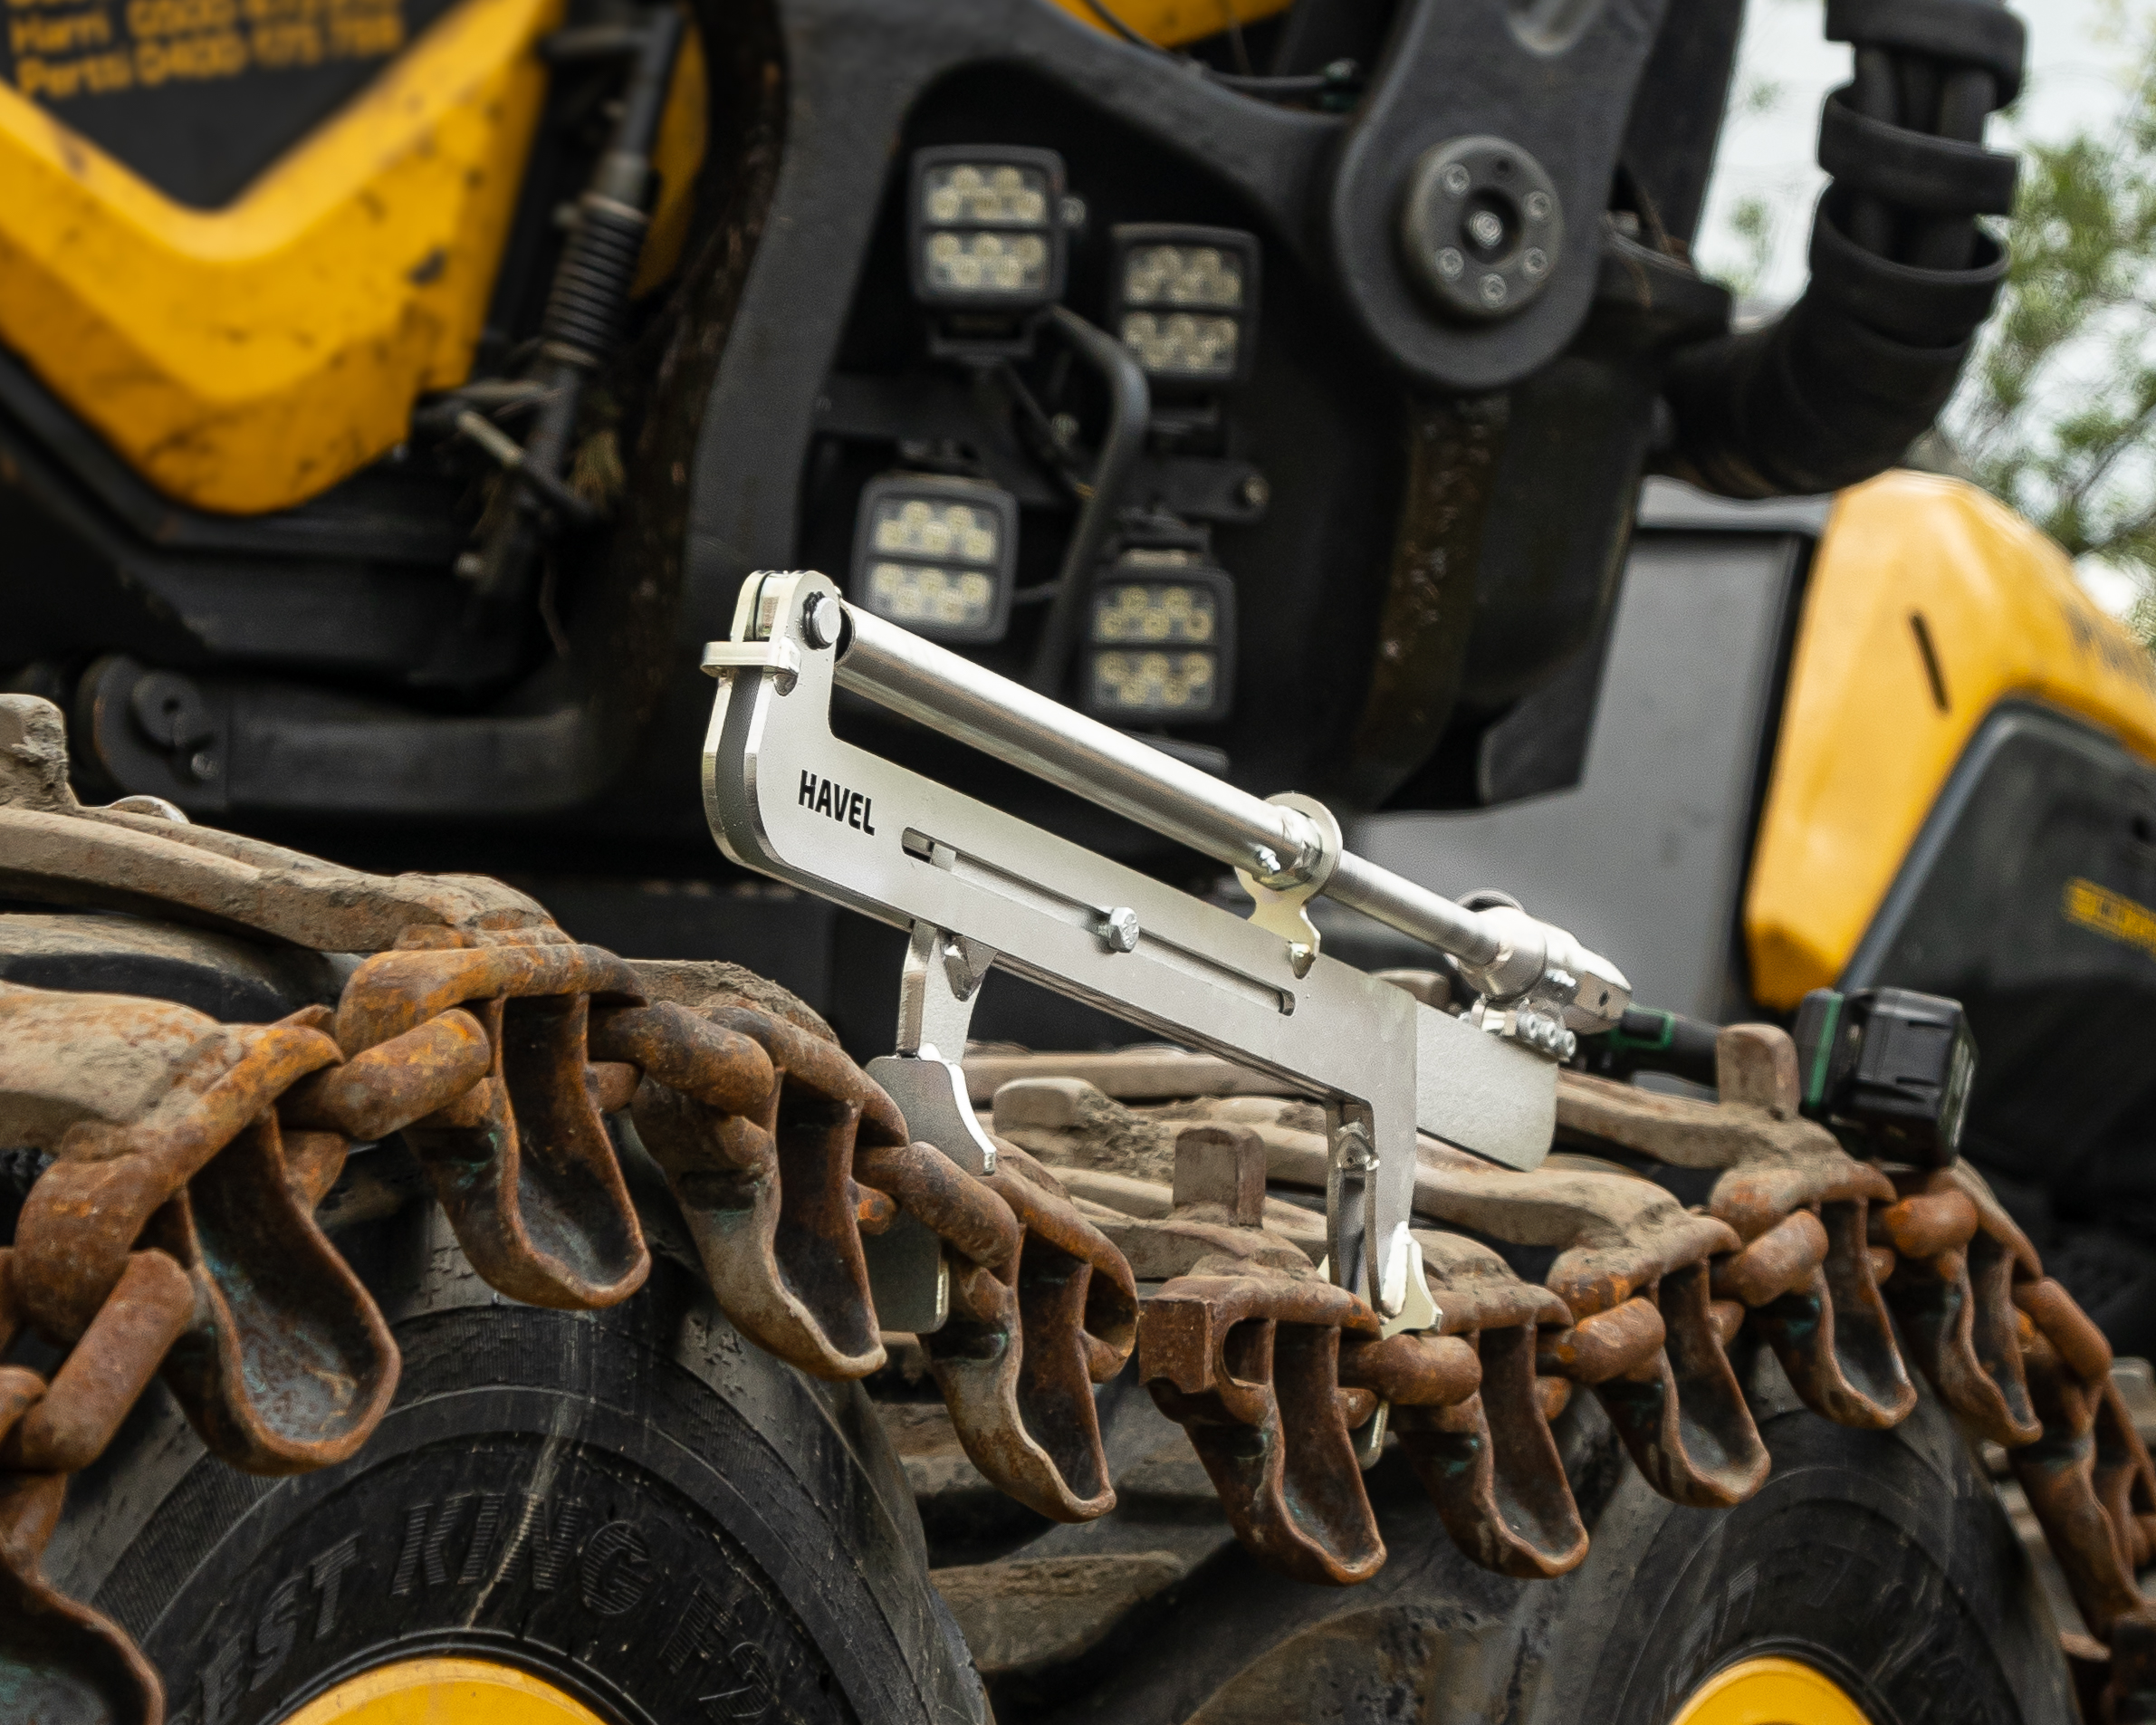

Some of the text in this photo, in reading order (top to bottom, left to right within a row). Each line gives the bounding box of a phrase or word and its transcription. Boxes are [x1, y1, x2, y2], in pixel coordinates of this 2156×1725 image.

[798, 769, 876, 837] HAVEL
[172, 1528, 364, 1725] EST
[390, 1491, 652, 1615] KING
